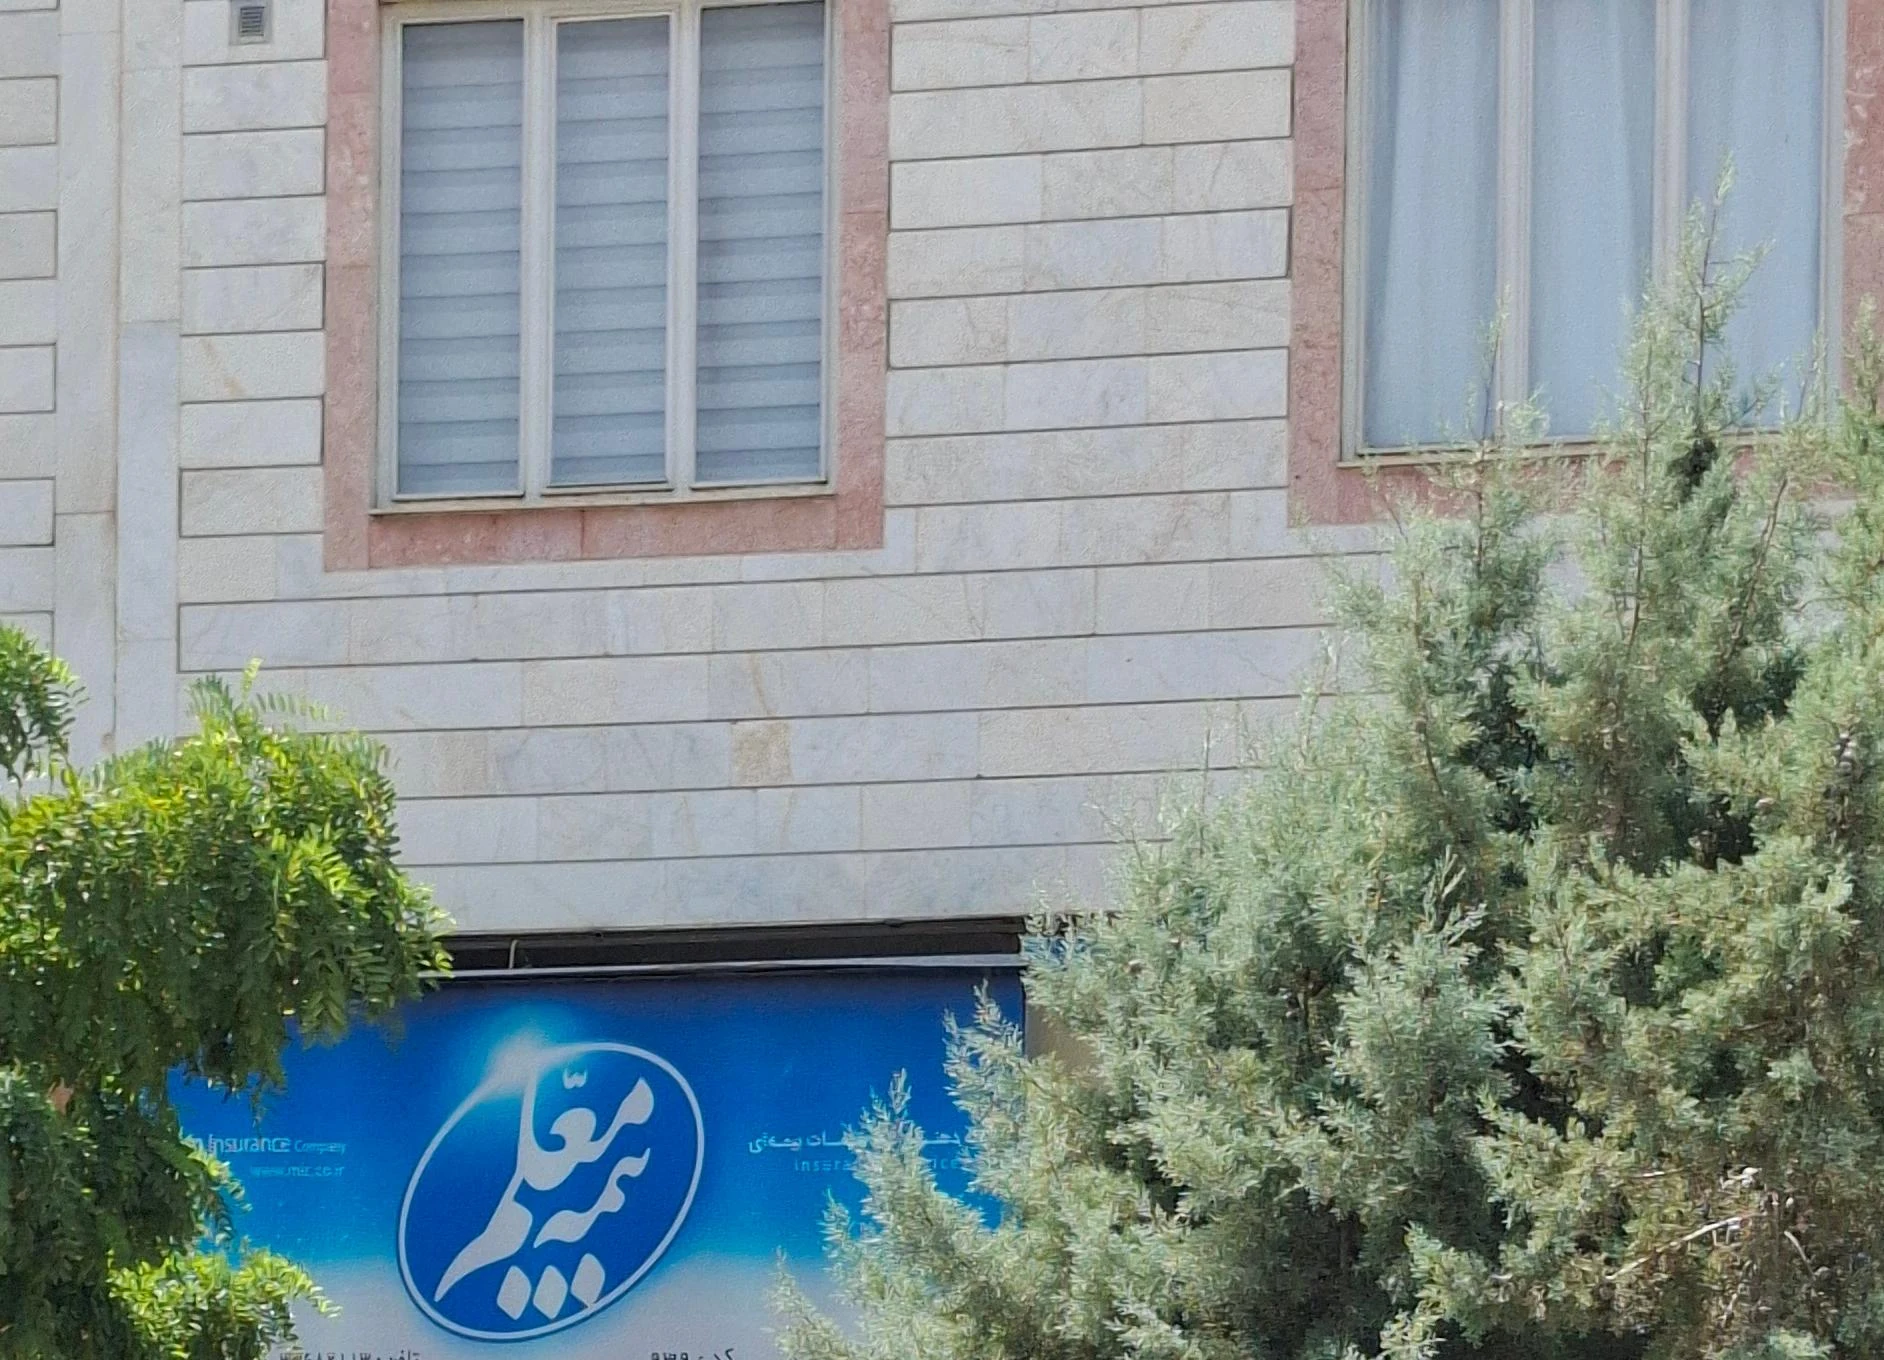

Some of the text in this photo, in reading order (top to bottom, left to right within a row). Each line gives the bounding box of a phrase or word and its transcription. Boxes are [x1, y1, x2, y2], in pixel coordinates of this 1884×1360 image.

[208, 1134, 291, 1153] Insurance
[294, 1139, 348, 1155] Company
[496, 1146, 652, 1321] بیمه
